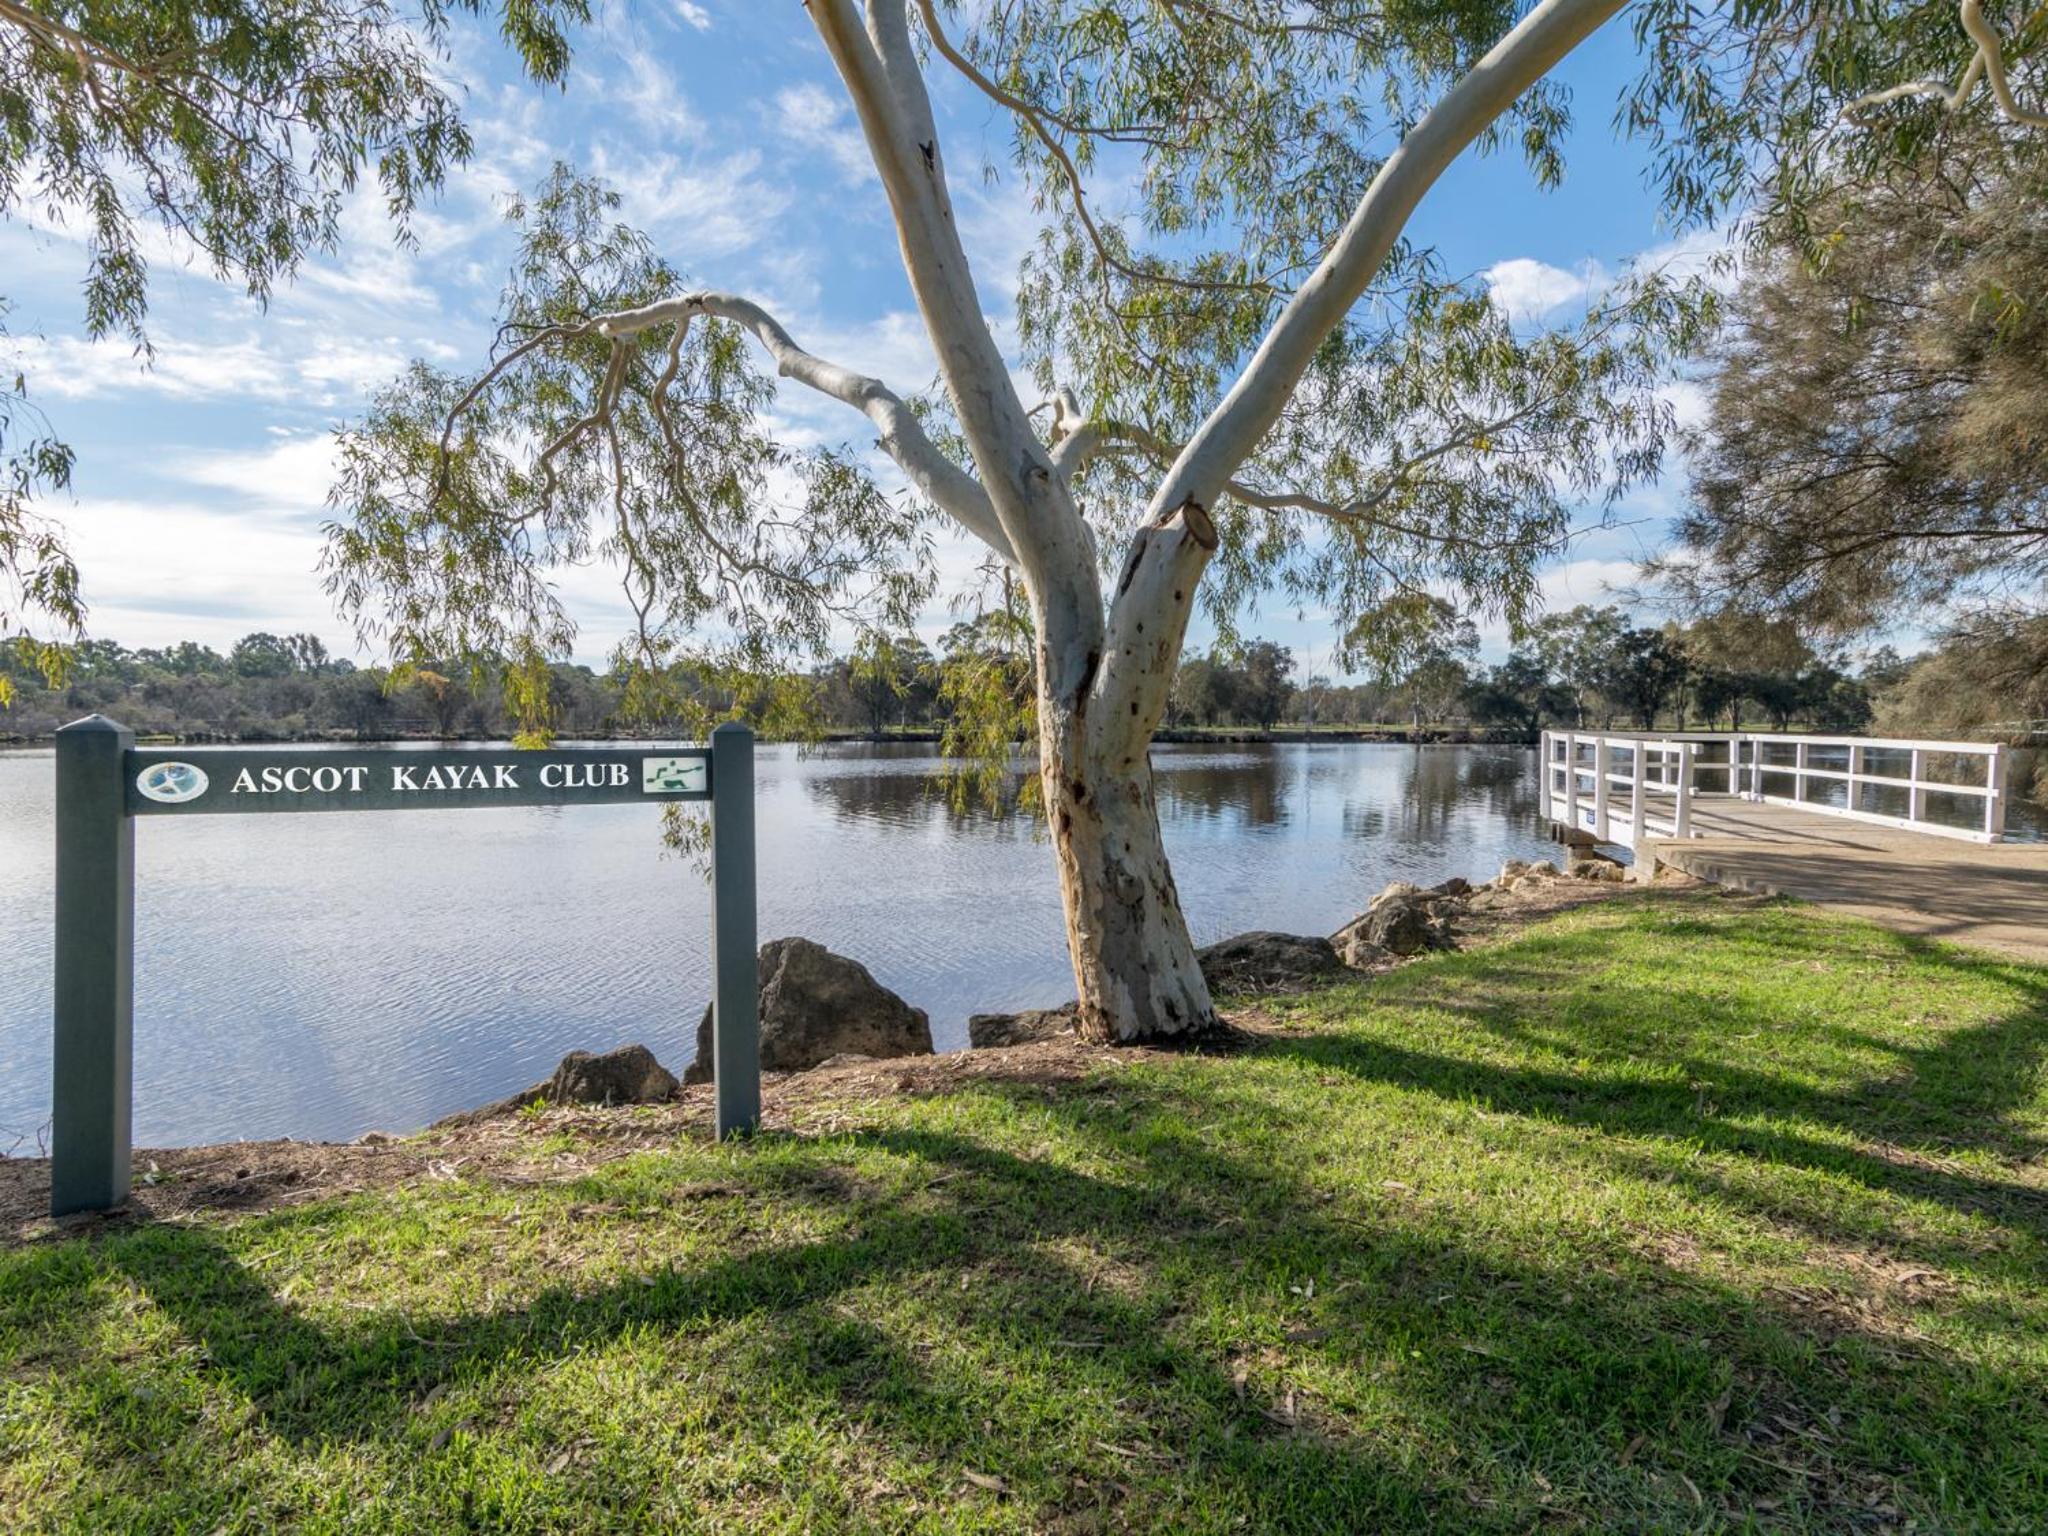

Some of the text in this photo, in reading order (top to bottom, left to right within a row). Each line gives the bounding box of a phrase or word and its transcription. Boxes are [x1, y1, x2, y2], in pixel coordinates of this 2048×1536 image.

[230, 763, 629, 793] ASCOT KAYAK CLUB
